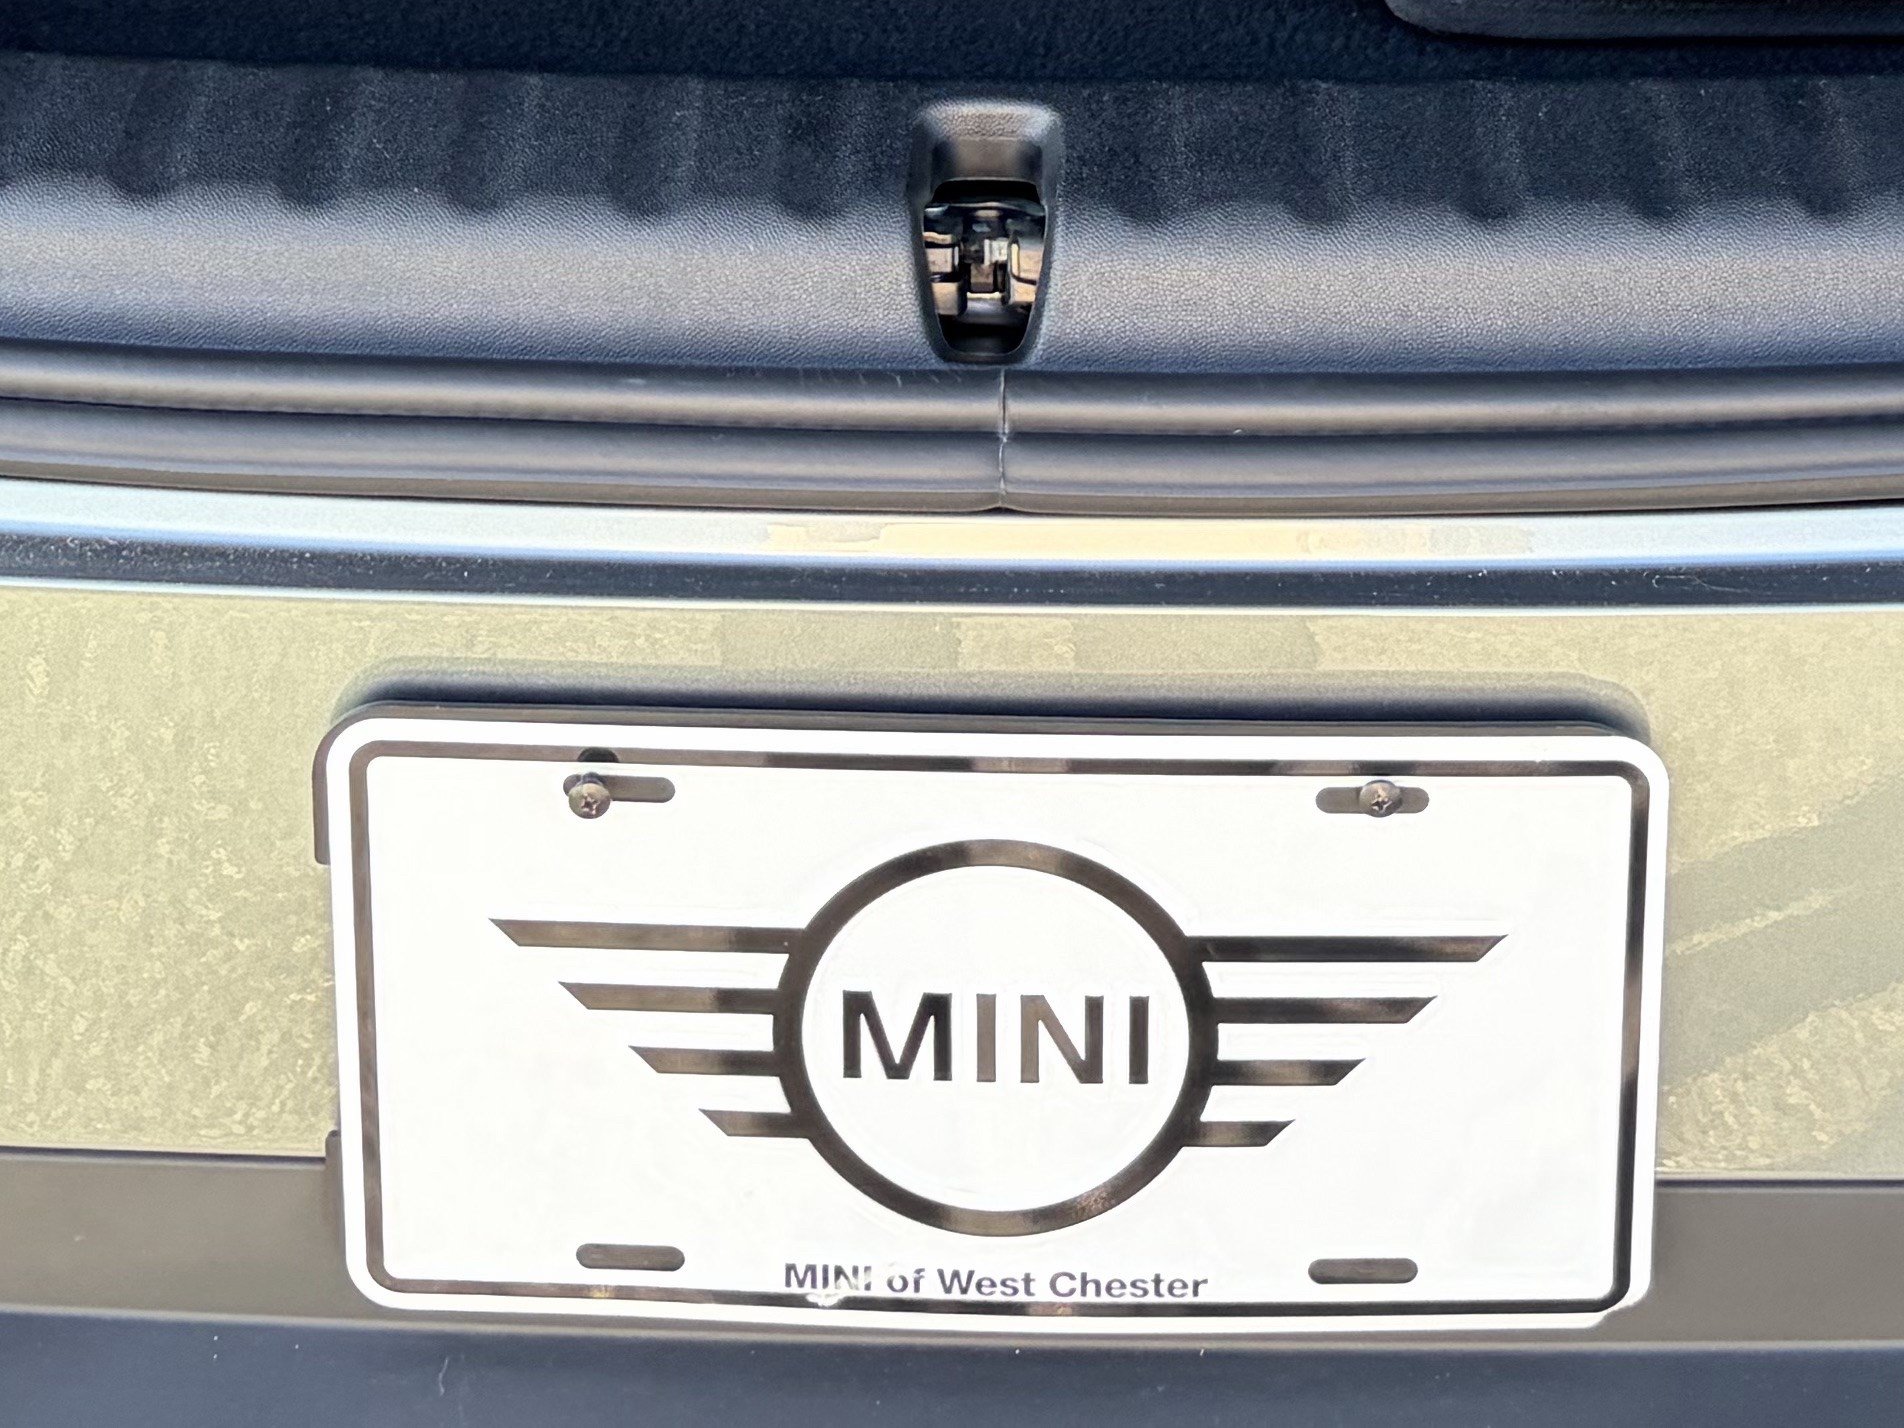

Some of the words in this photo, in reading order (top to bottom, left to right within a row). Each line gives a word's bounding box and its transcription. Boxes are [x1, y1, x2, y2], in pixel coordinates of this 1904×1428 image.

[842, 989, 1150, 1085] MINI
[784, 1262, 873, 1291] MINI
[886, 1267, 926, 1294] of
[936, 1268, 1036, 1297] West
[1048, 1271, 1209, 1299] Chester
